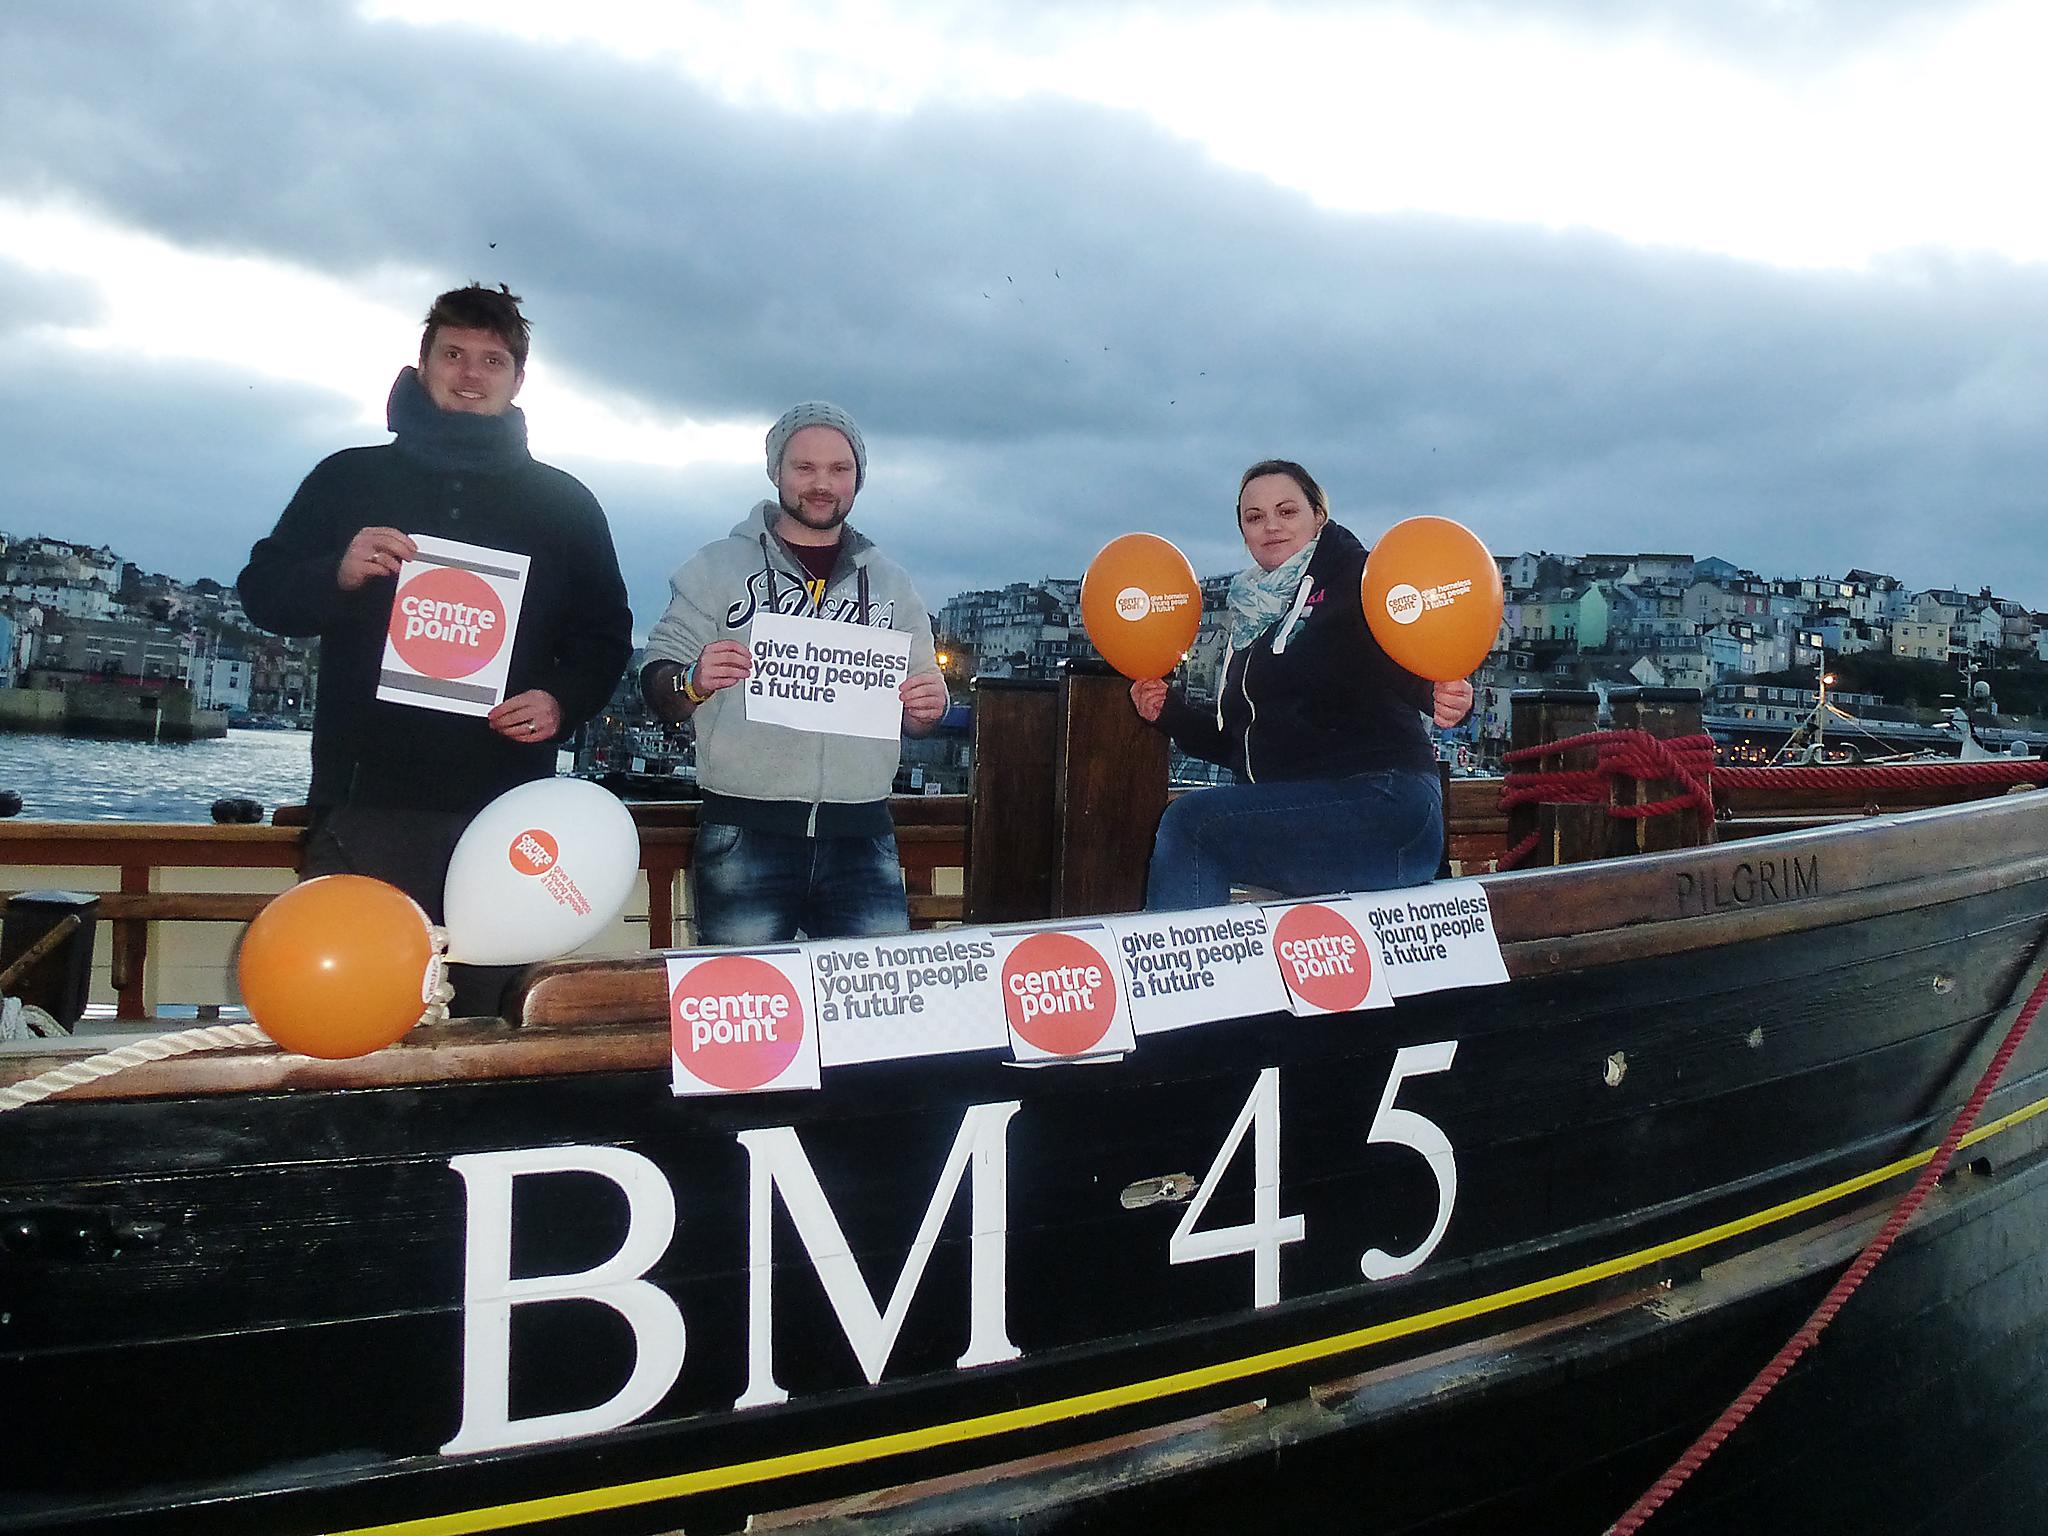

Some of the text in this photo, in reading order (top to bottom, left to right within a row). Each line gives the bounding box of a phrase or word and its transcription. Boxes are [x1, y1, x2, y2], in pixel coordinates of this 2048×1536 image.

[401, 596, 496, 629] centre
[1388, 593, 1417, 607] centre
[1392, 601, 1416, 615] point
[405, 616, 481, 647] point
[754, 639, 907, 671] give homeless
[750, 678, 836, 703] a future
[753, 659, 896, 691] young people
[521, 833, 553, 865] centre
[1676, 854, 1819, 912] PILGRIM
[1368, 896, 1487, 930] give homeless
[1121, 918, 1267, 957] give homeless
[1280, 933, 1357, 961] centre
[1375, 915, 1485, 949] young people
[816, 940, 995, 977] give homeless
[1125, 937, 1264, 980] young people
[1292, 955, 1354, 985] point
[1382, 942, 1447, 966] a future
[819, 960, 988, 1001] young people
[1009, 964, 1102, 995] centre
[1132, 967, 1215, 998] a future
[679, 991, 789, 1021] centre
[822, 991, 924, 1022] a future
[1020, 985, 1095, 1024] point
[691, 1015, 778, 1052] point
[438, 1040, 1458, 1456] BM 45
